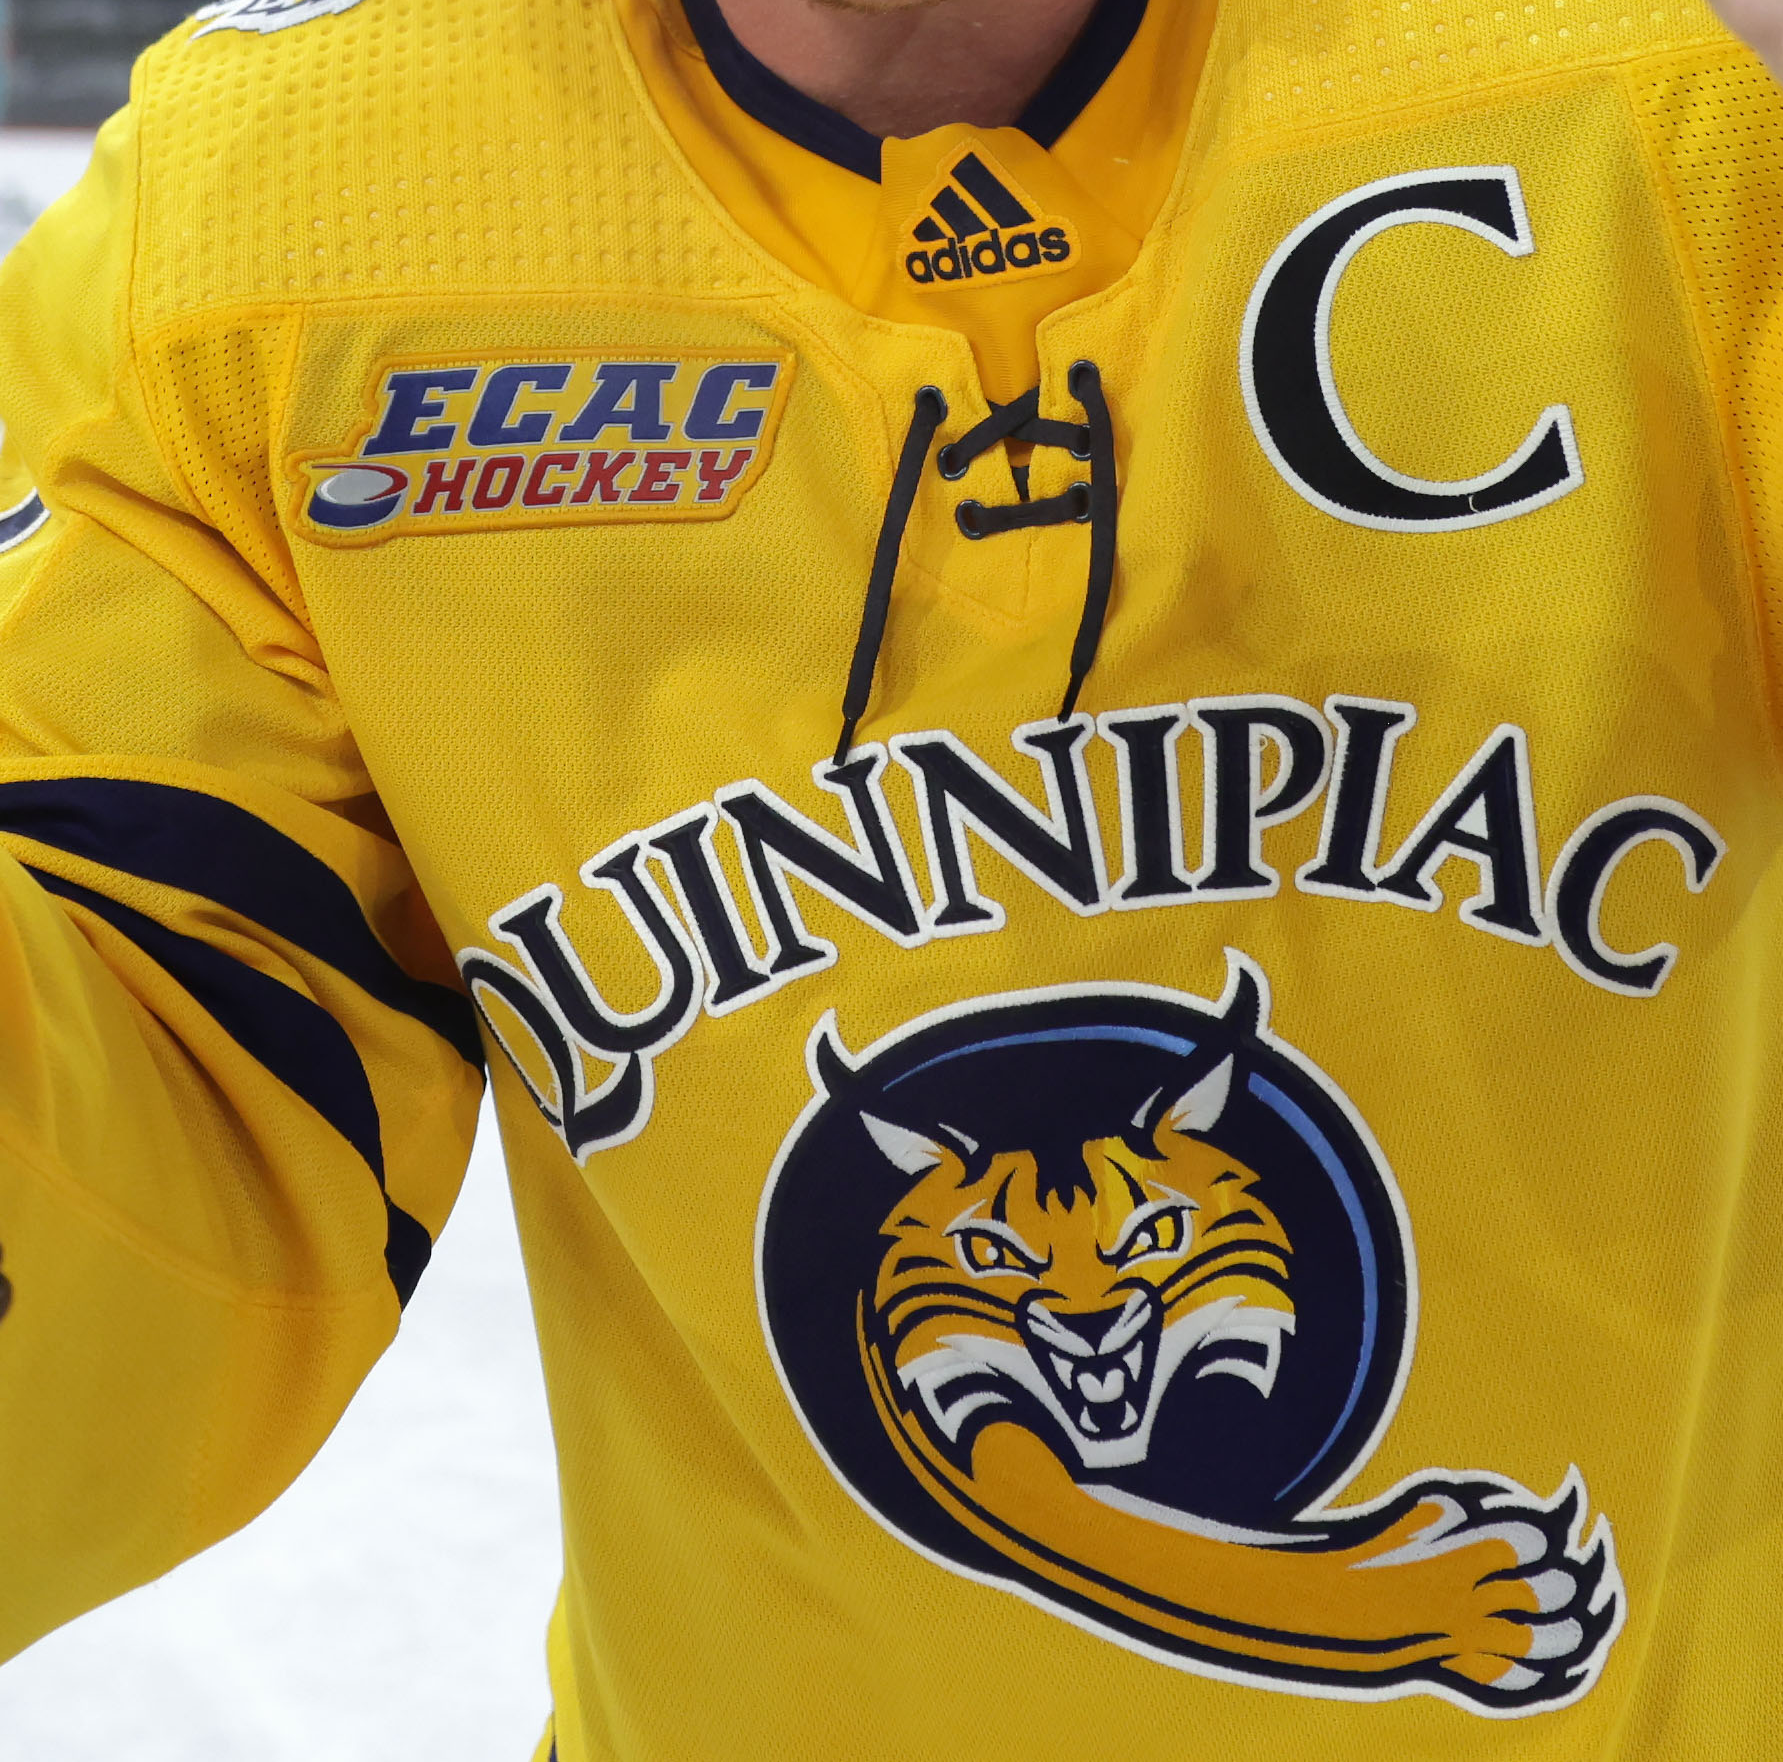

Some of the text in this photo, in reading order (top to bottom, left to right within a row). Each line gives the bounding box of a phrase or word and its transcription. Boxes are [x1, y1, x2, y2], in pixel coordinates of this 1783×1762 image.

[905, 222, 1071, 284] adidas
[1238, 164, 1586, 534] C
[360, 360, 778, 456] ECAC
[412, 448, 754, 515] HOCKEY
[455, 693, 1728, 1166] QUINNIPIAC
